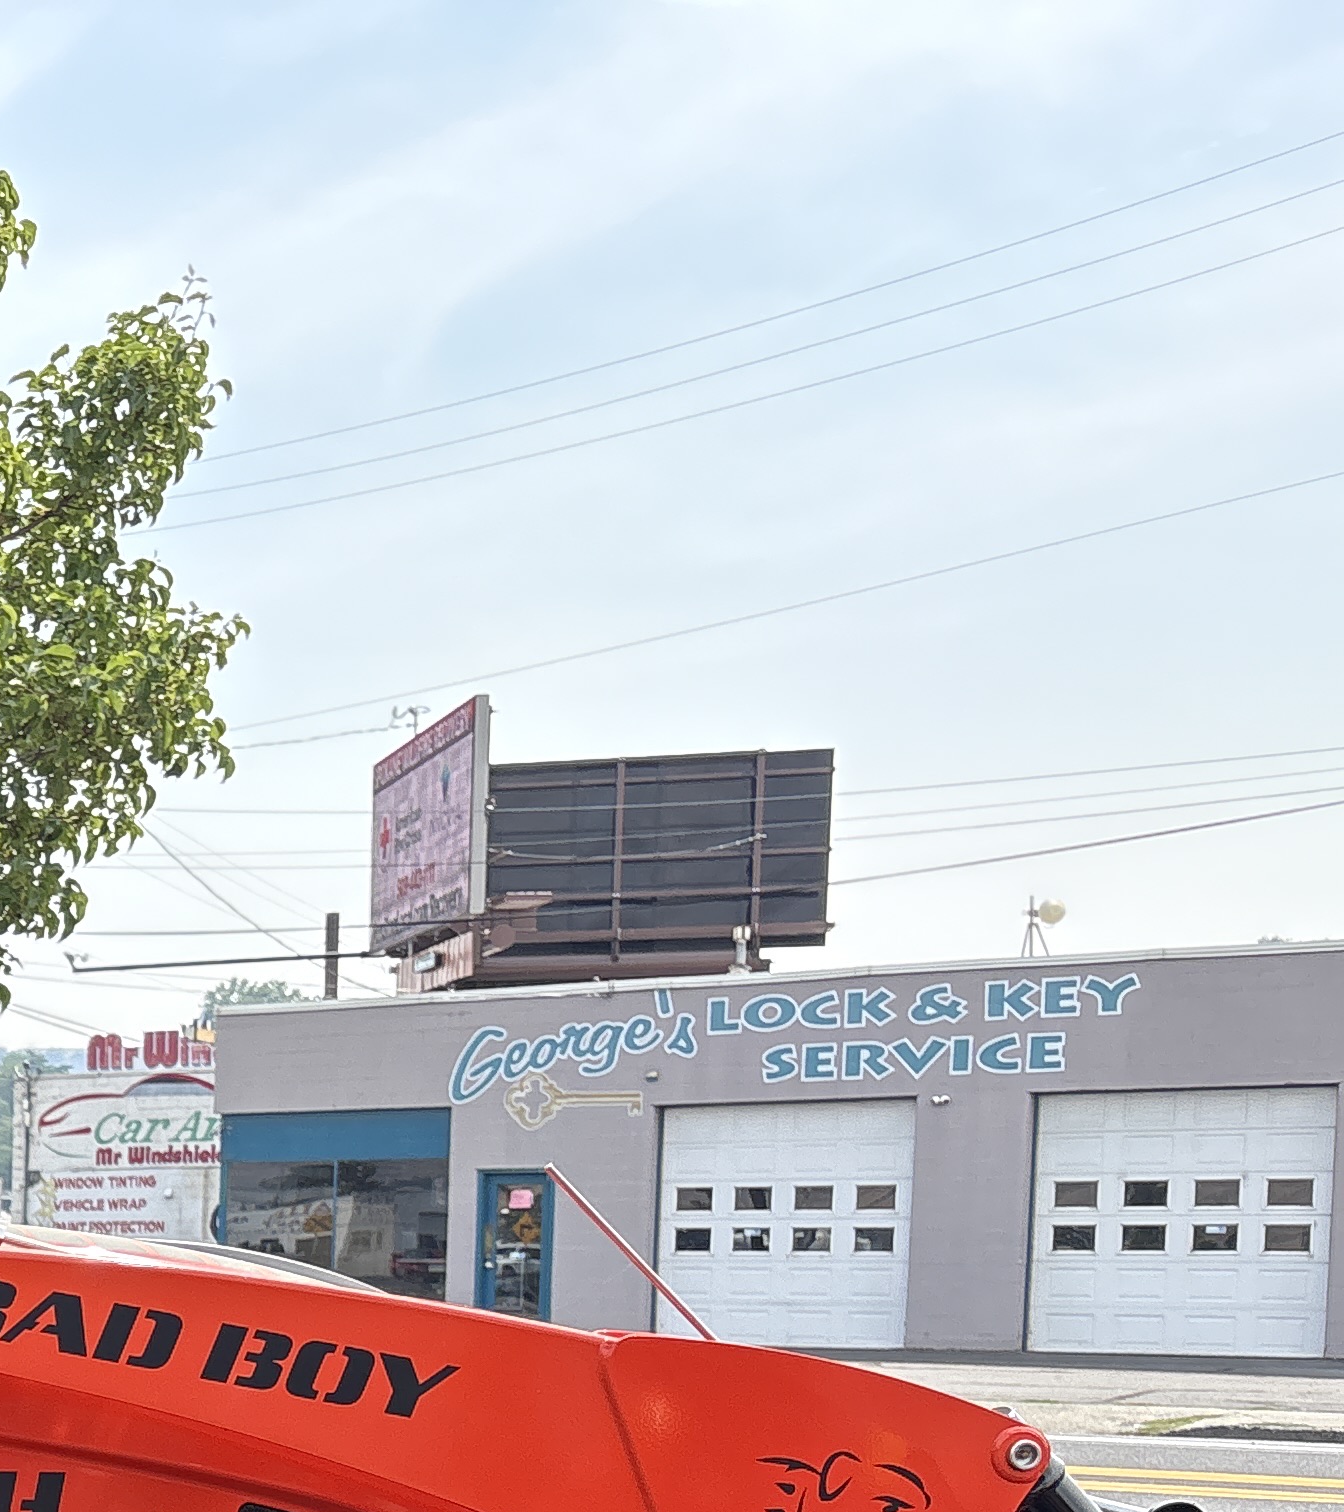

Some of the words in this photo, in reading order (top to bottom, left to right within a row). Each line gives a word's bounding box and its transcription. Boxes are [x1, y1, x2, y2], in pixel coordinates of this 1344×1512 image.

[87, 1033, 139, 1070] Mr
[448, 988, 698, 1104] George's
[706, 987, 897, 1035] LOCK
[908, 982, 968, 1024] &
[984, 973, 1141, 1022] KEY
[762, 1031, 1066, 1083] SERVICE
[94, 1112, 169, 1145] Car
[96, 1148, 122, 1165] Mr
[128, 1144, 220, 1165] Windshiel
[53, 1177, 104, 1189] WINDOW
[108, 1175, 157, 1188] TINTING
[54, 1199, 104, 1211] VEHICLE
[107, 1198, 146, 1211] WRAP
[200, 1322, 461, 1418] BOY
